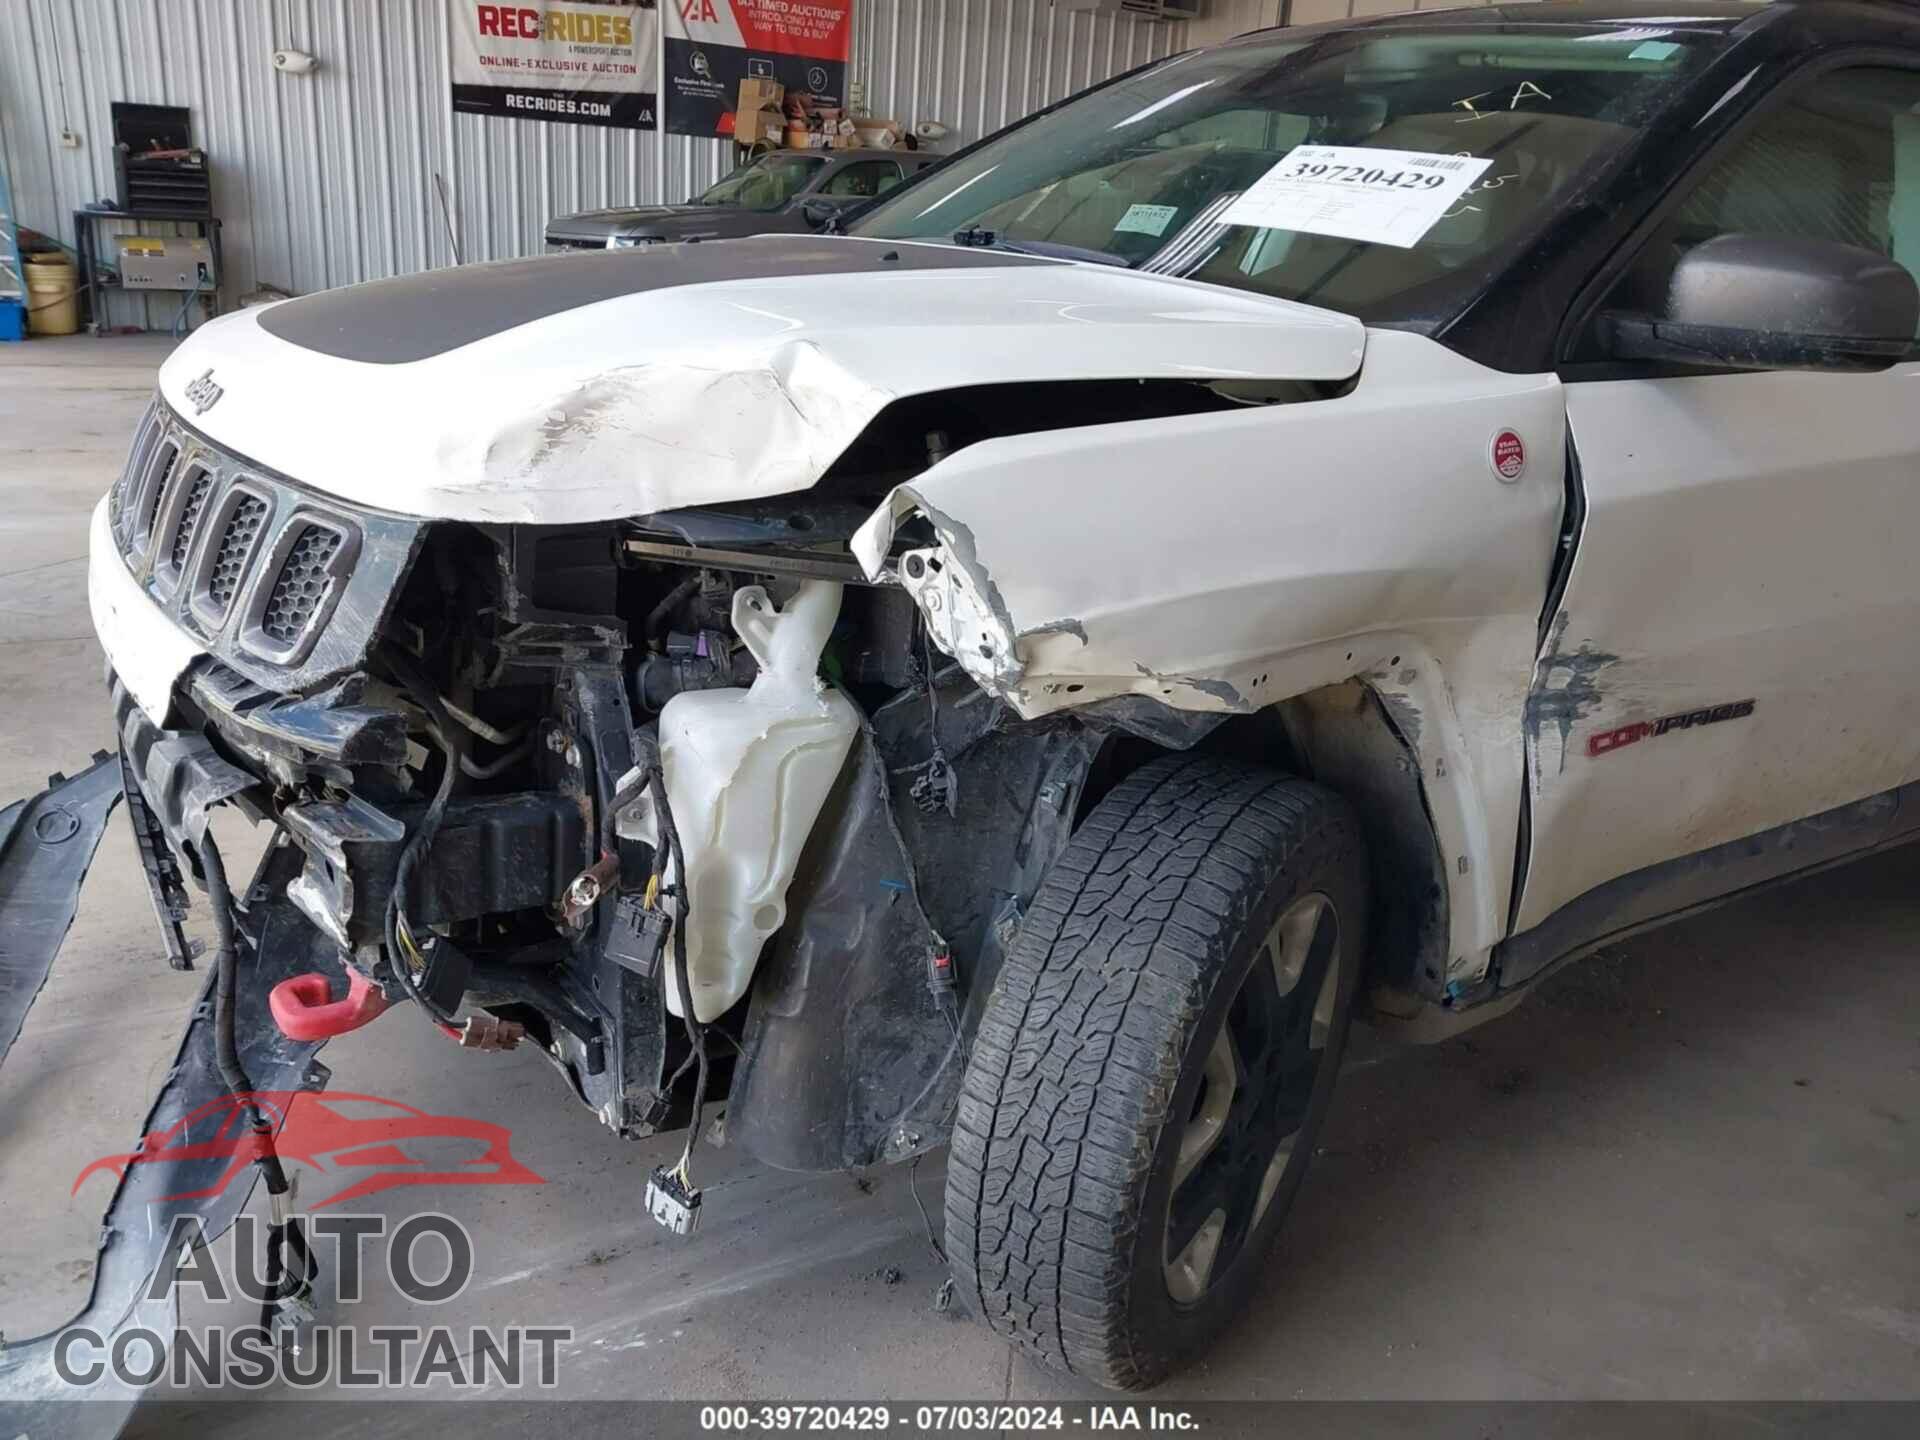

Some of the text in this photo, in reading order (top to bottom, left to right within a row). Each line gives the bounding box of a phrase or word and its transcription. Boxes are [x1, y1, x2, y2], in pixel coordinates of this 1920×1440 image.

[478, 5, 633, 46] REC RIDES
[480, 55, 637, 74] ONLINE-EXCLUSIVE AUCTION
[506, 93, 611, 117] RECRIDES.COM
[1285, 163, 1445, 190] 39720429
[184, 368, 224, 416] Jeep
